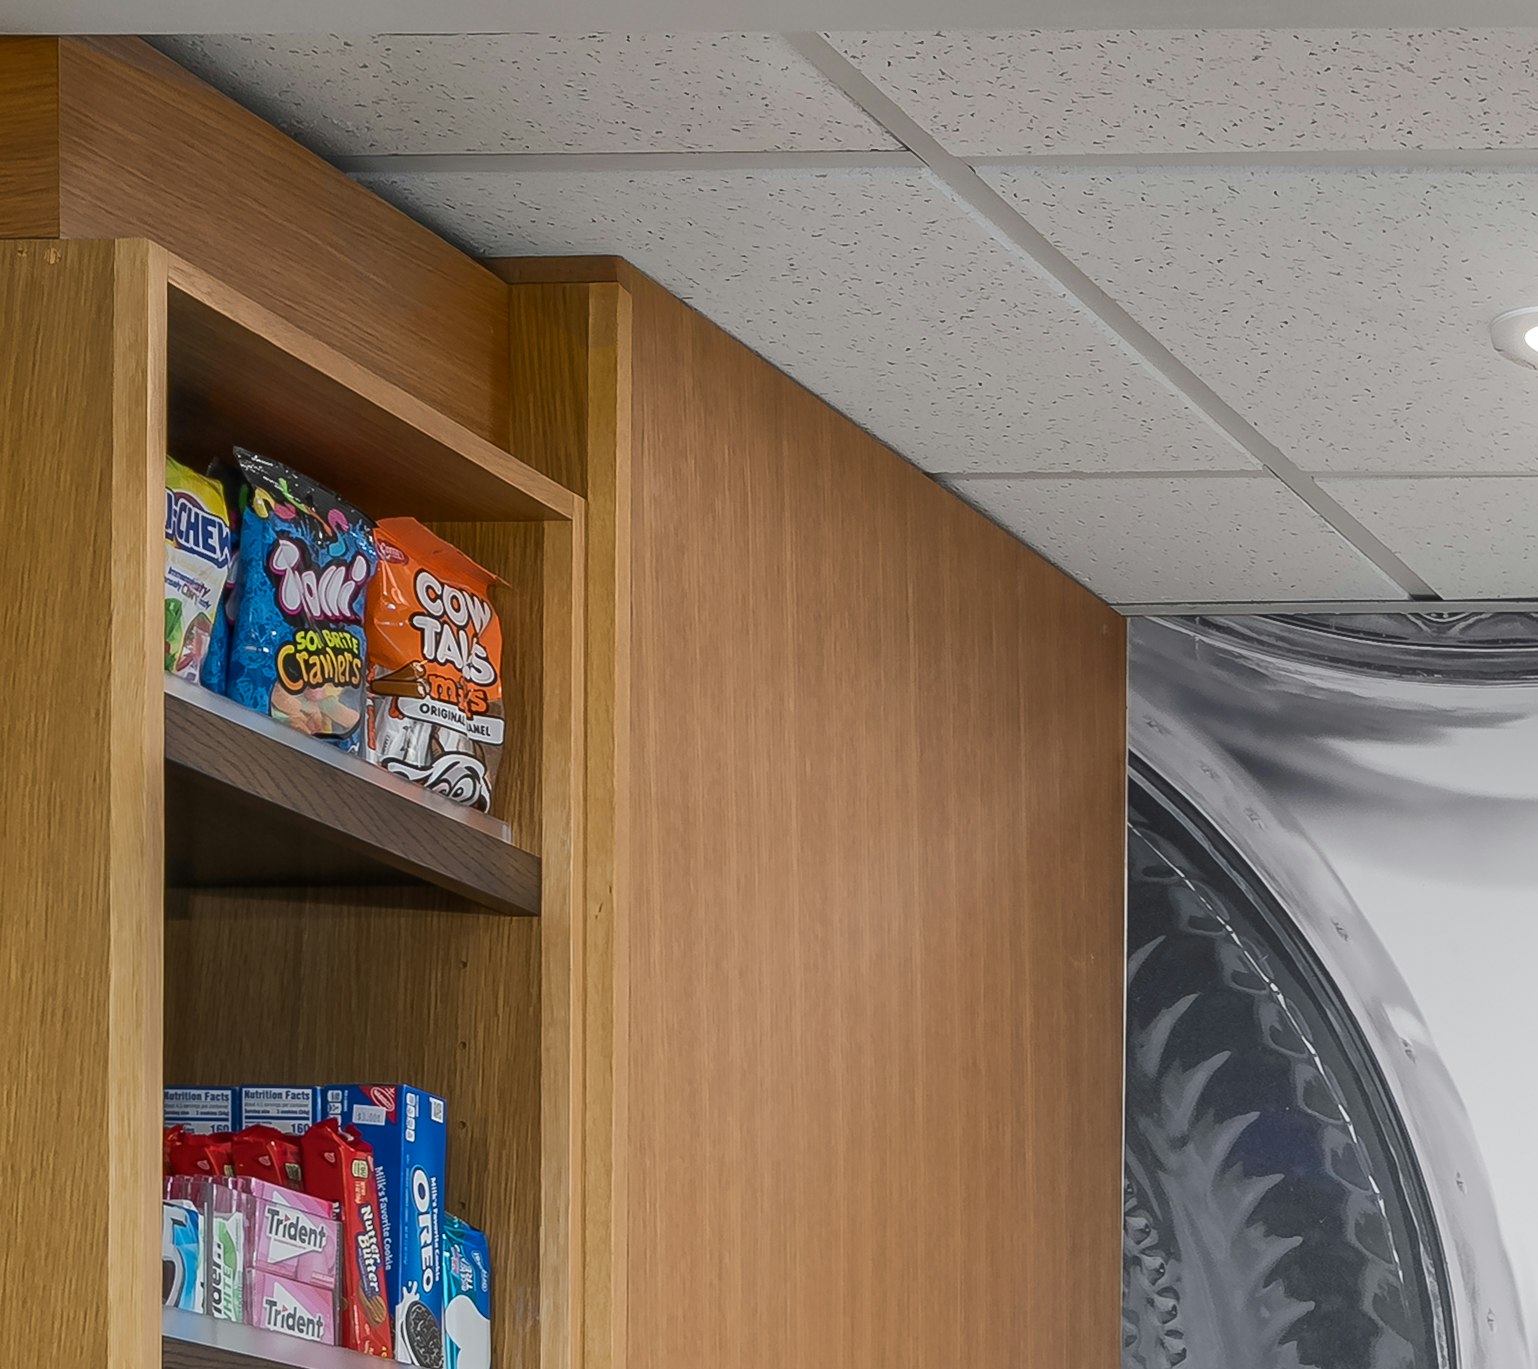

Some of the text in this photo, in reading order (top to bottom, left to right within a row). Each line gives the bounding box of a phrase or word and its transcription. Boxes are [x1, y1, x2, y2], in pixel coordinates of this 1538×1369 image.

[415, 572, 490, 635] COW
[278, 645, 361, 690] Crawlers
[265, 1208, 326, 1250] Trident
[411, 1168, 434, 1293] OREO
